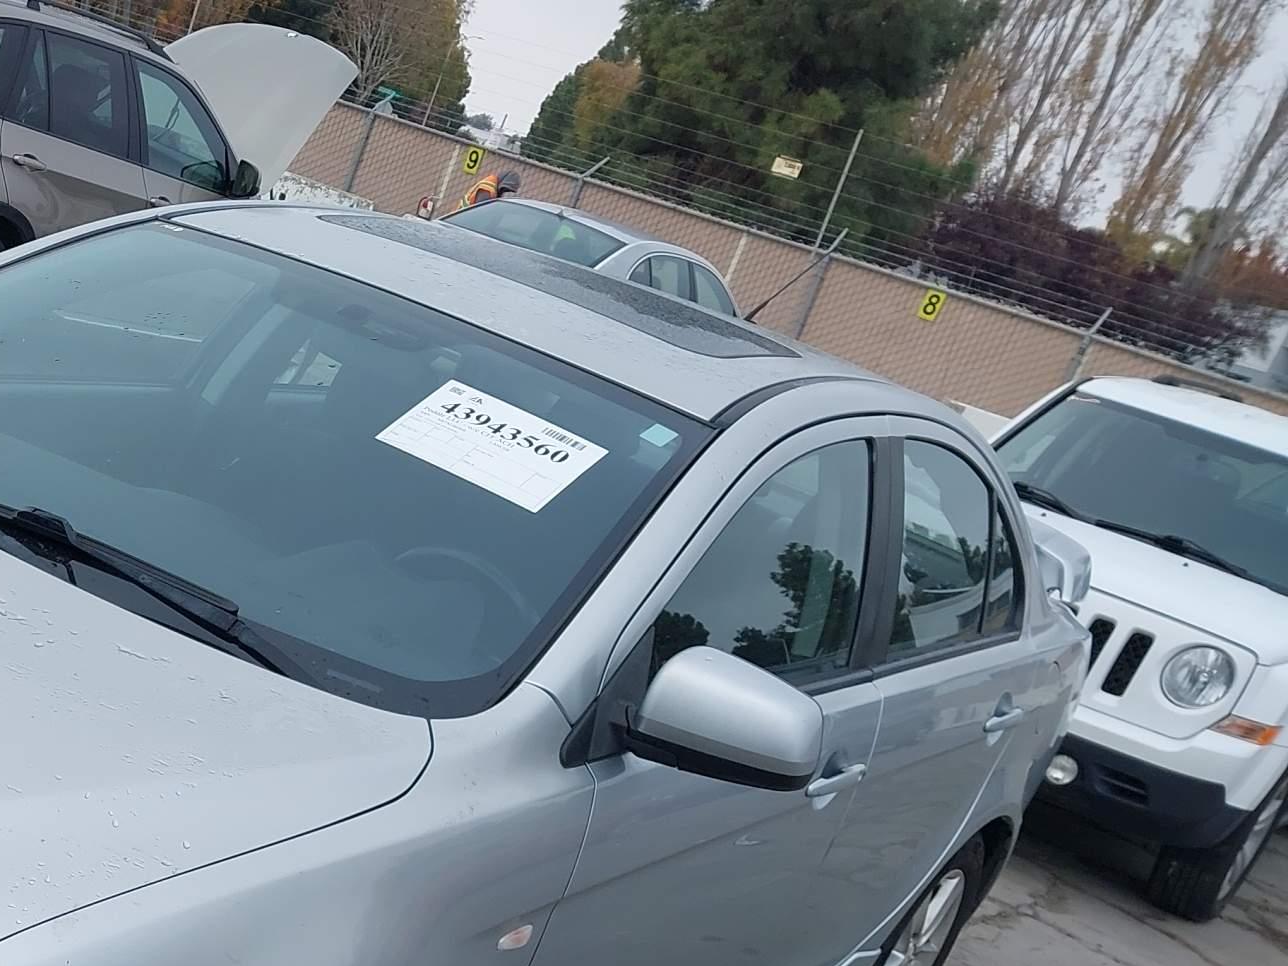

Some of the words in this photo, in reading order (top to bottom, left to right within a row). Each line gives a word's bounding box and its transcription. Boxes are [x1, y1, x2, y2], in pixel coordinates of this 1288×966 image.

[466, 150, 479, 169] 9
[923, 294, 941, 315] 8
[440, 403, 570, 463] 43943560
